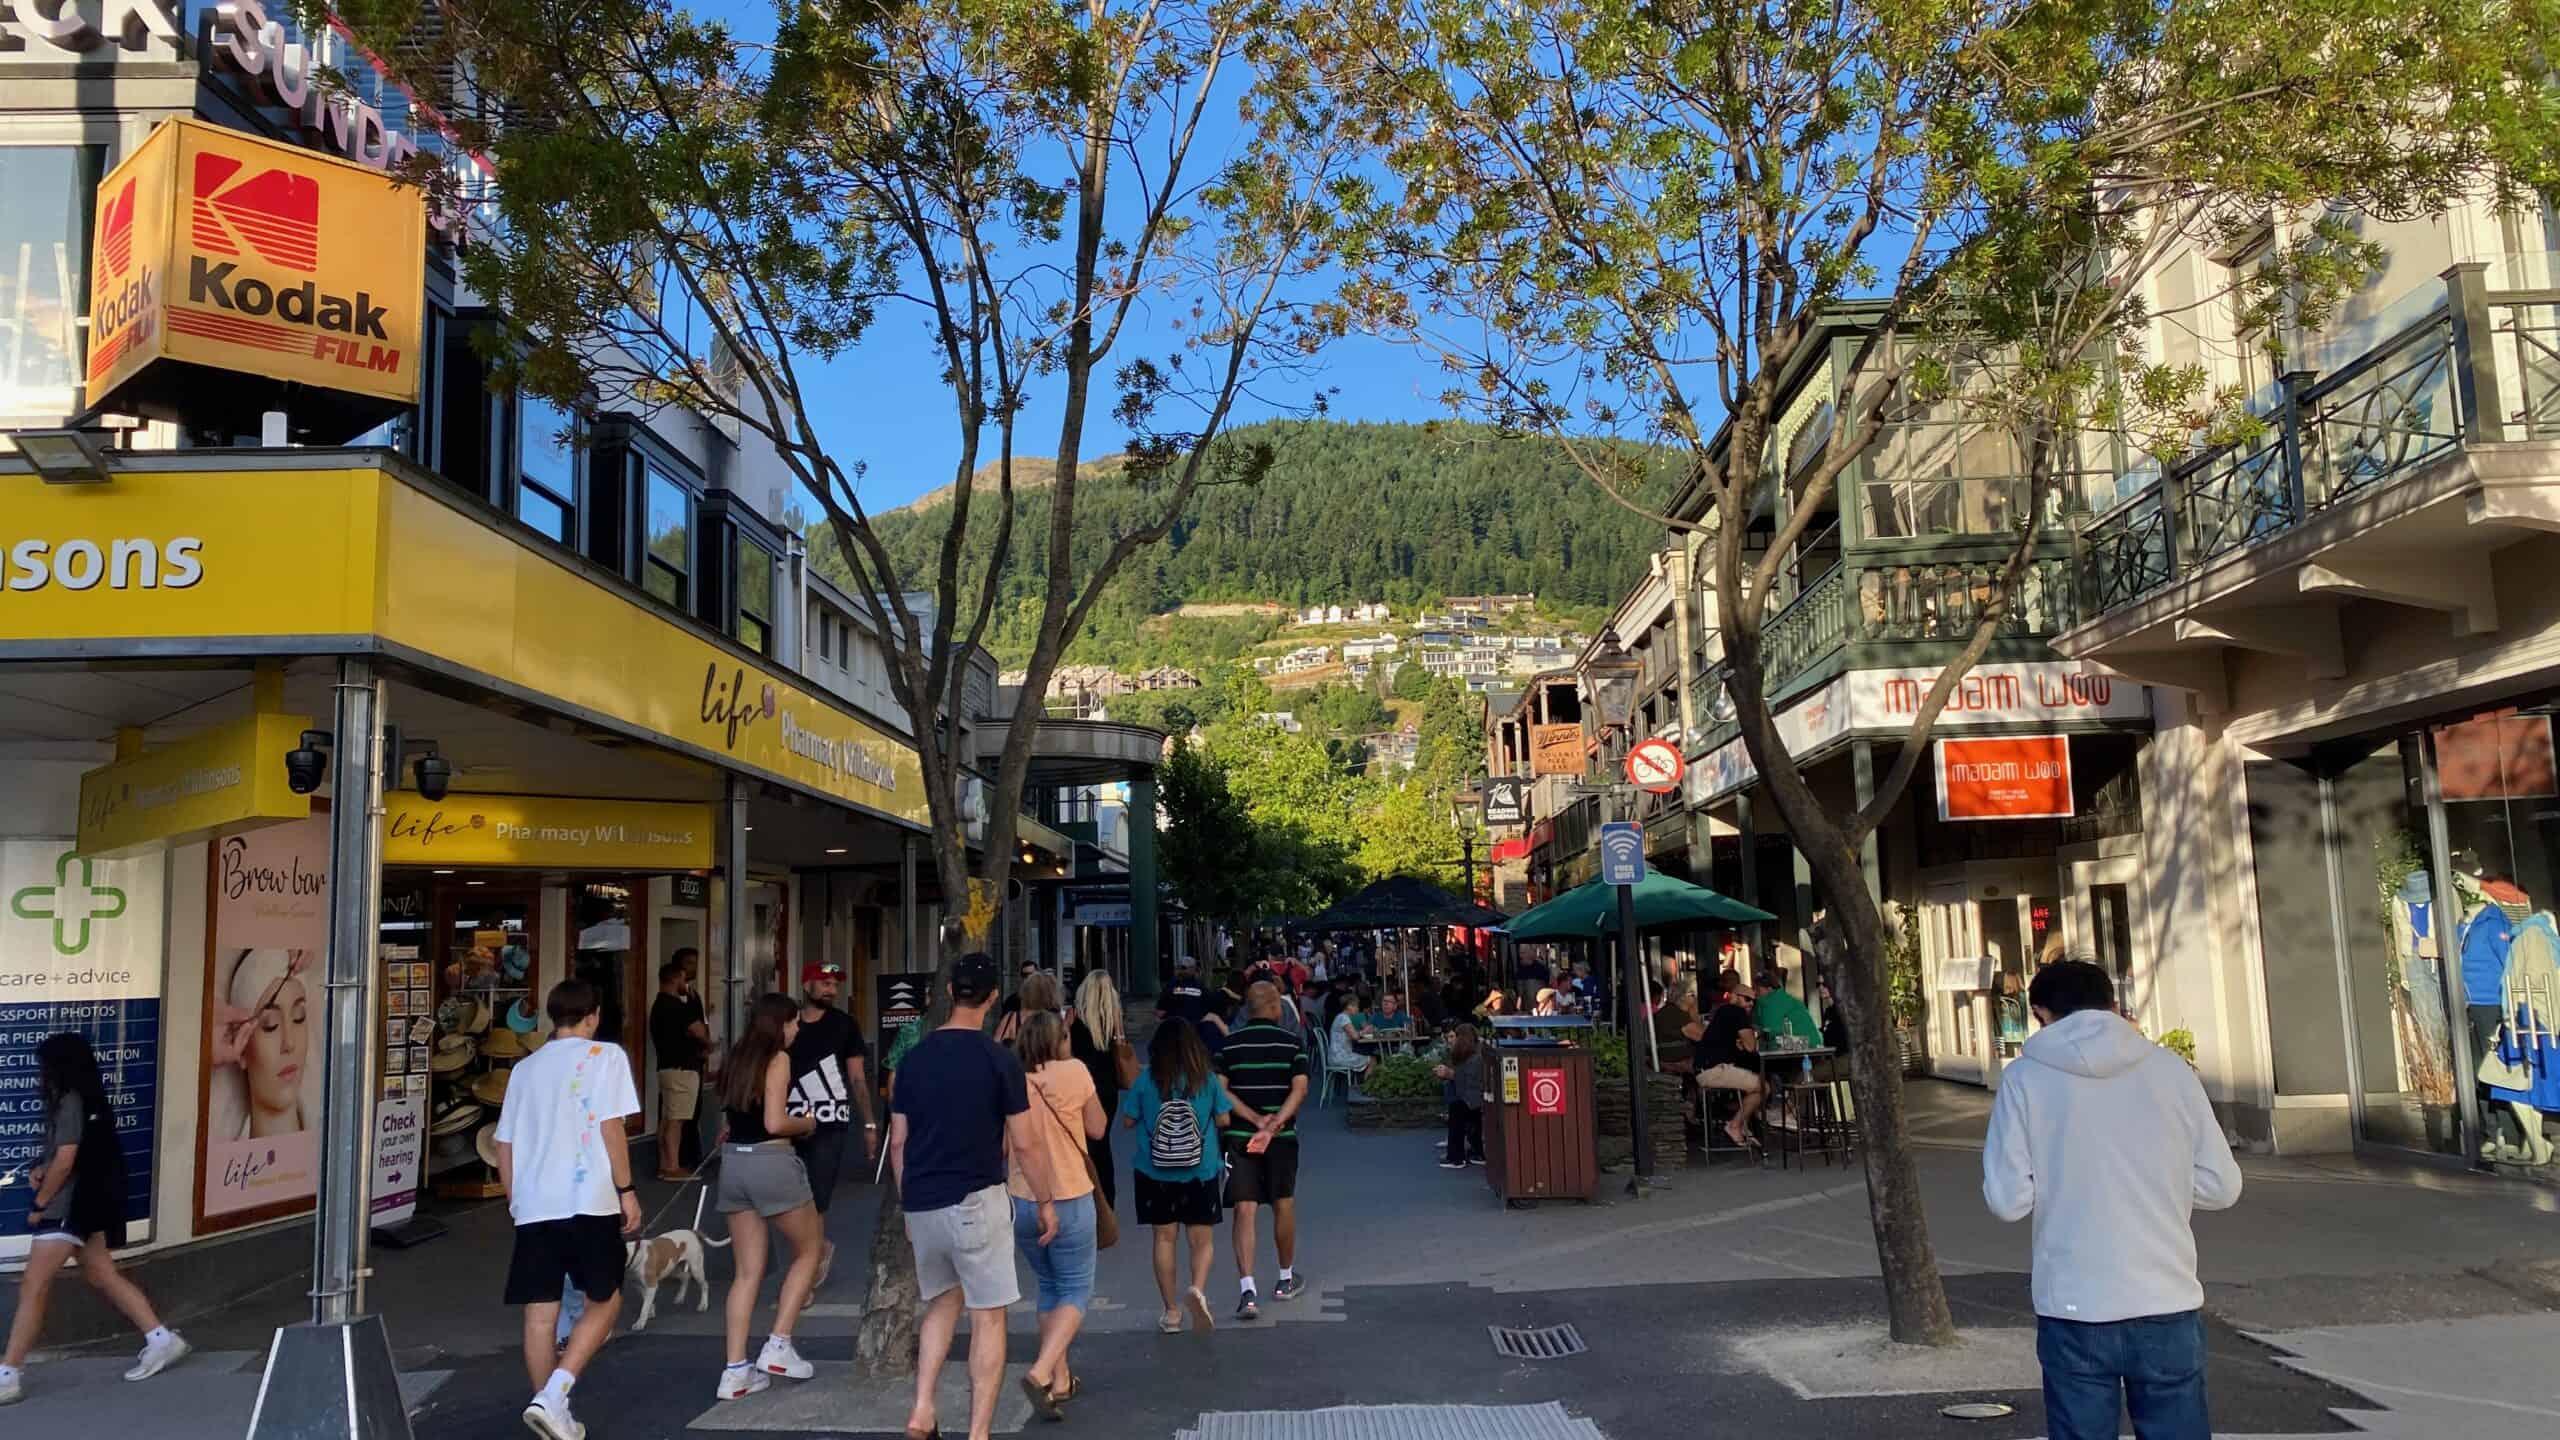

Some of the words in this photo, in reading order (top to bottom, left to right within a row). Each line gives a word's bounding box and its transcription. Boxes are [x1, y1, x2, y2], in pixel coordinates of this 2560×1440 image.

[95, 265, 152, 346] Kodak
[189, 255, 389, 340] Kodak
[312, 335, 400, 374] FILM
[0, 537, 204, 590] sons
[702, 662, 763, 750] life
[391, 812, 469, 846] life
[496, 822, 590, 846] Phamacy
[223, 847, 289, 900] Brow
[293, 855, 327, 896] bar
[67, 968, 131, 985] advice
[60, 1005, 117, 1020] PHOTOS
[382, 1111, 416, 1133] Check
[379, 1151, 414, 1169] hearing
[380, 1136, 398, 1151] your
[223, 1151, 266, 1191] life
